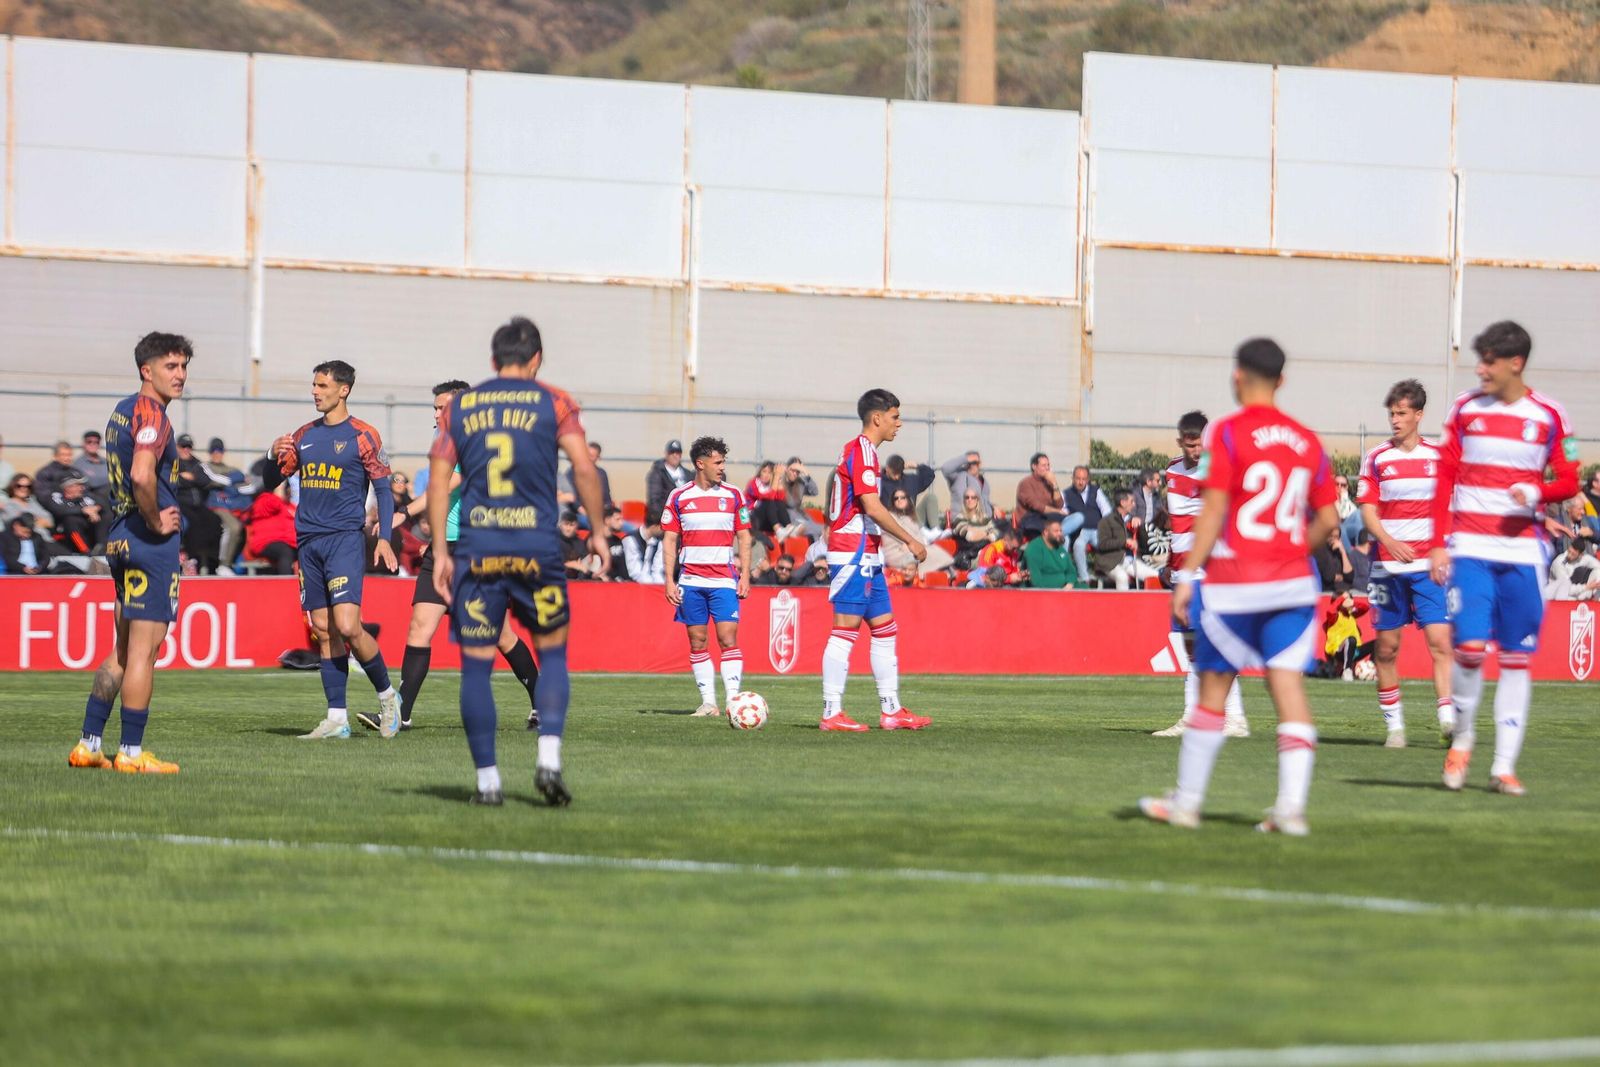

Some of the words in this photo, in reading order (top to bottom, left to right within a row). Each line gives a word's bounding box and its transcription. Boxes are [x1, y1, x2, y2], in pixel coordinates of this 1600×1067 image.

[503, 408, 538, 432] RUIZ
[485, 432, 514, 498] 2
[1236, 460, 1311, 545] 24
